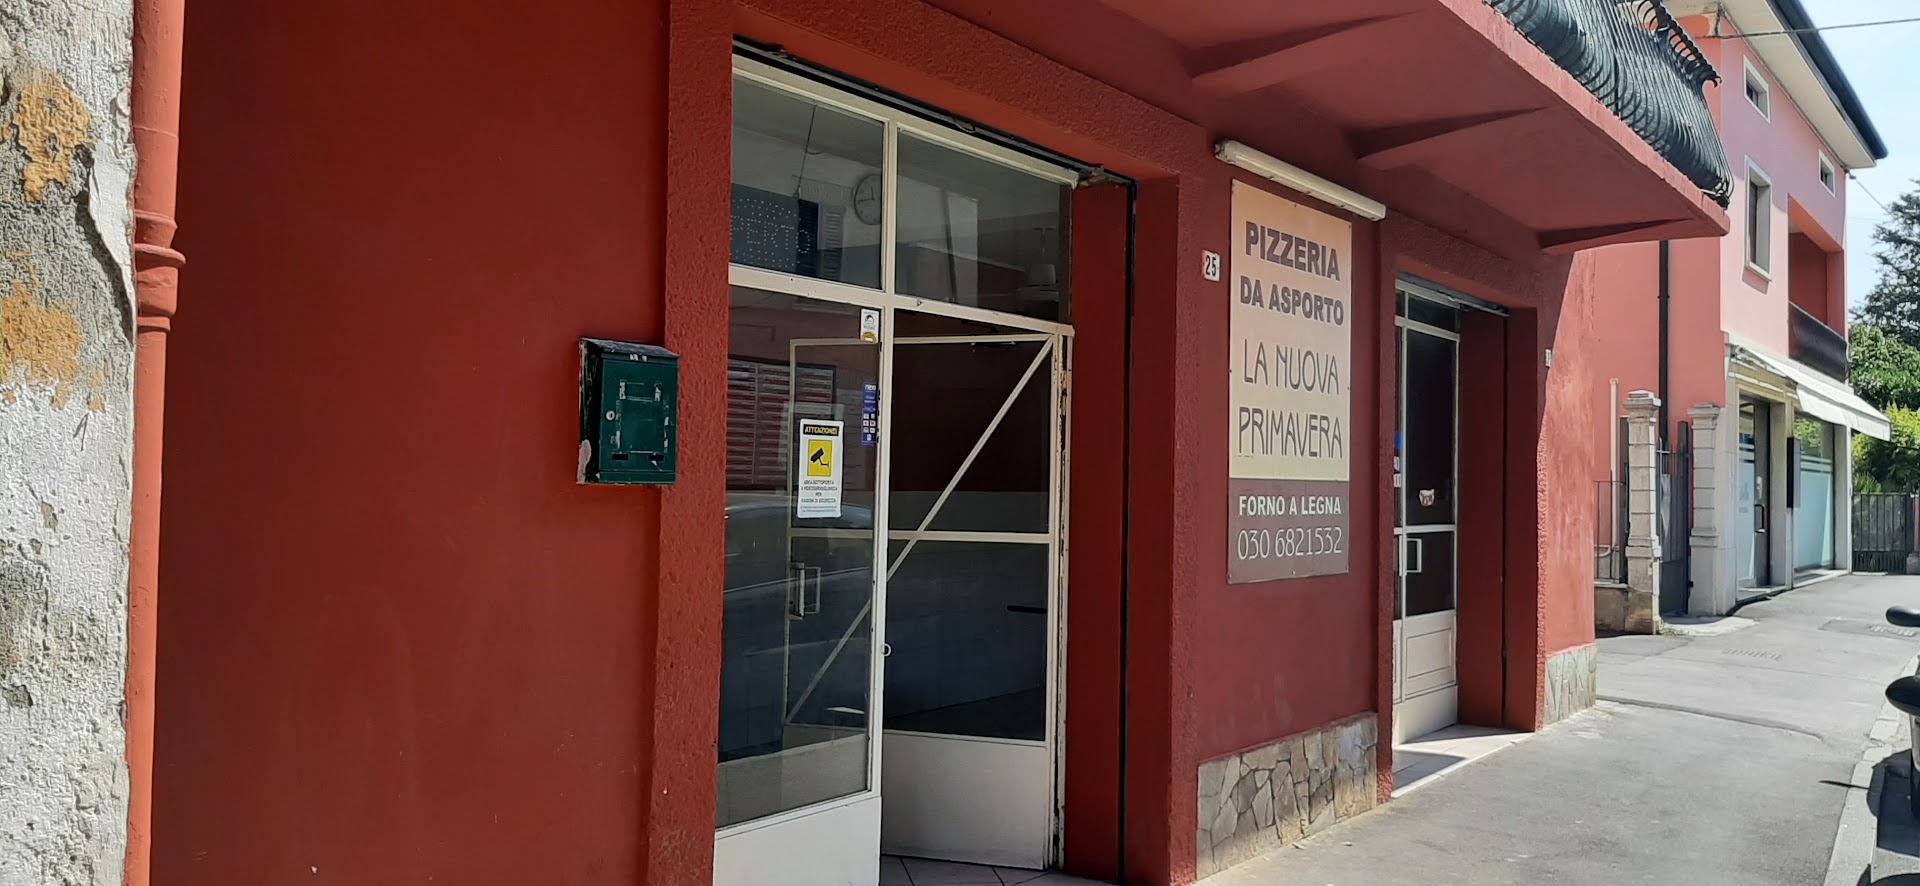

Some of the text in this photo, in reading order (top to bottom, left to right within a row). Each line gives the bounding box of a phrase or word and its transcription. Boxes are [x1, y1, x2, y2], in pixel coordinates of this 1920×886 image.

[1205, 254, 1217, 277] 25
[1245, 220, 1341, 282] PIZZERIA
[1240, 275, 1344, 326] DA ASPORTO
[1244, 338, 1340, 396] LA NUOVA
[1239, 406, 1343, 459] PRIMAVERA
[1239, 495, 1342, 516] FORNO A LEGNA
[1237, 526, 1343, 560] 030 6821532
